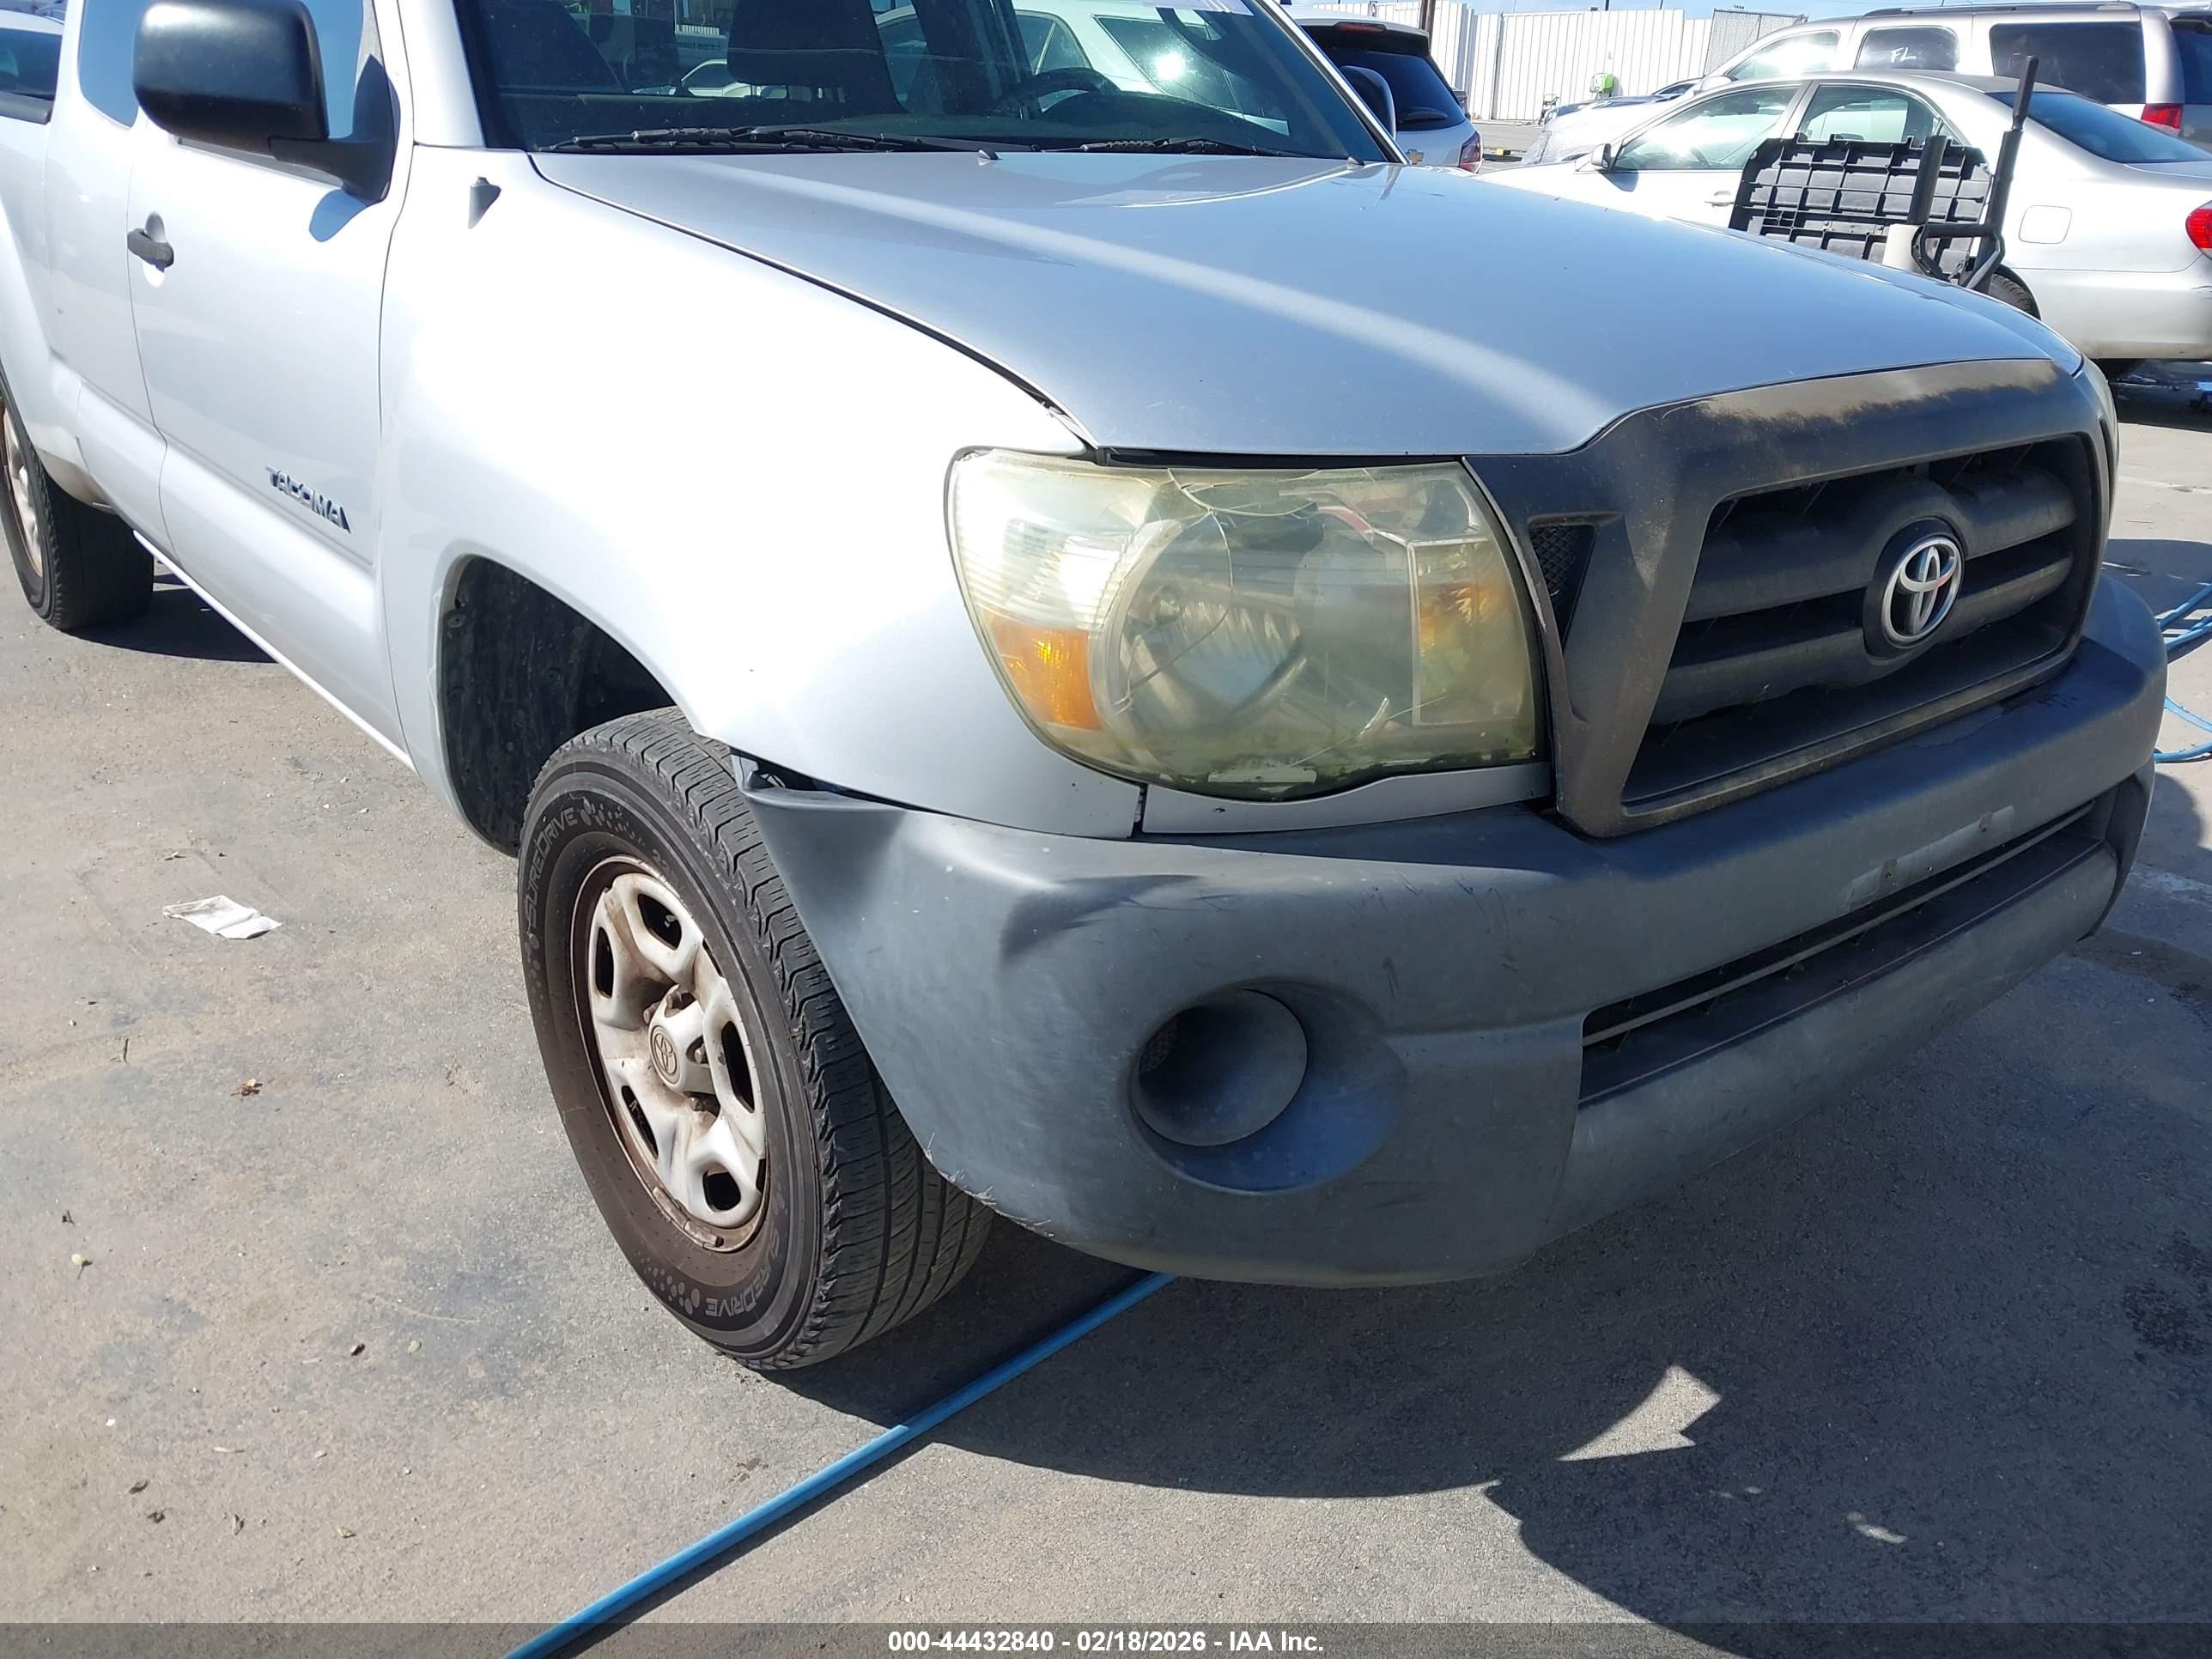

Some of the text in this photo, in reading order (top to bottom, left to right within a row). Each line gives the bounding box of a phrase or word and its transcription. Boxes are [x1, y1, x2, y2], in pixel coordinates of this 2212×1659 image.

[1891, 46, 1917, 63] FL
[265, 465, 351, 533] TACOMA
[525, 807, 578, 928] SUREDRIVE
